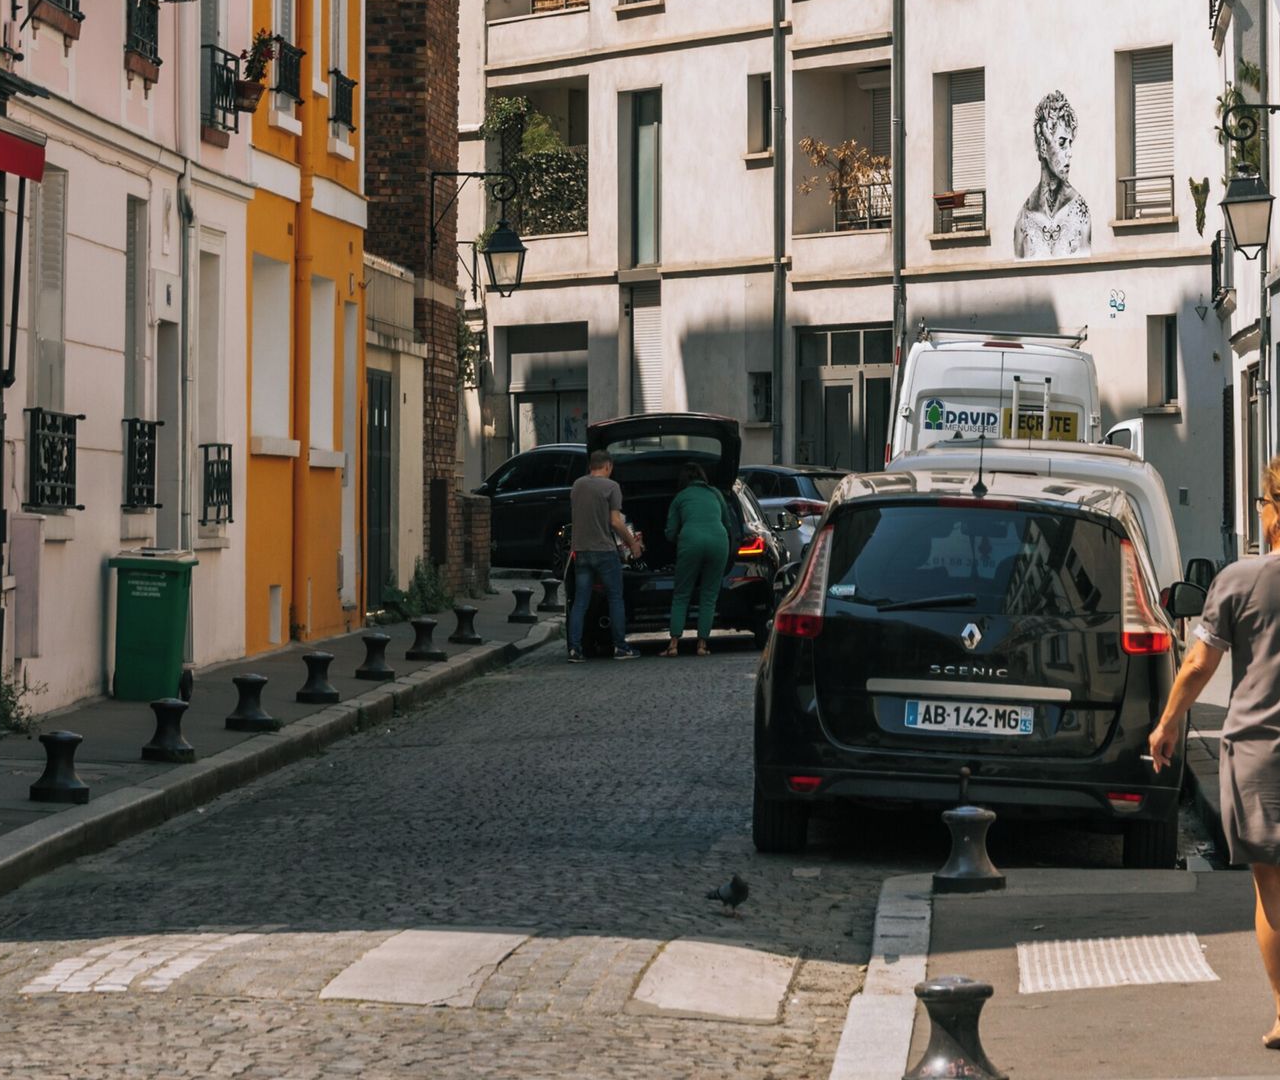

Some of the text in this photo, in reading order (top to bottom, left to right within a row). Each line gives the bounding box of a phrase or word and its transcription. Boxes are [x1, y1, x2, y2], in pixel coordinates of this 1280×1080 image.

[946, 411, 998, 426] DAVID
[944, 423, 998, 434] MENUISERIE
[929, 664, 1009, 678] SCENIC
[1020, 721, 1032, 731] 45
